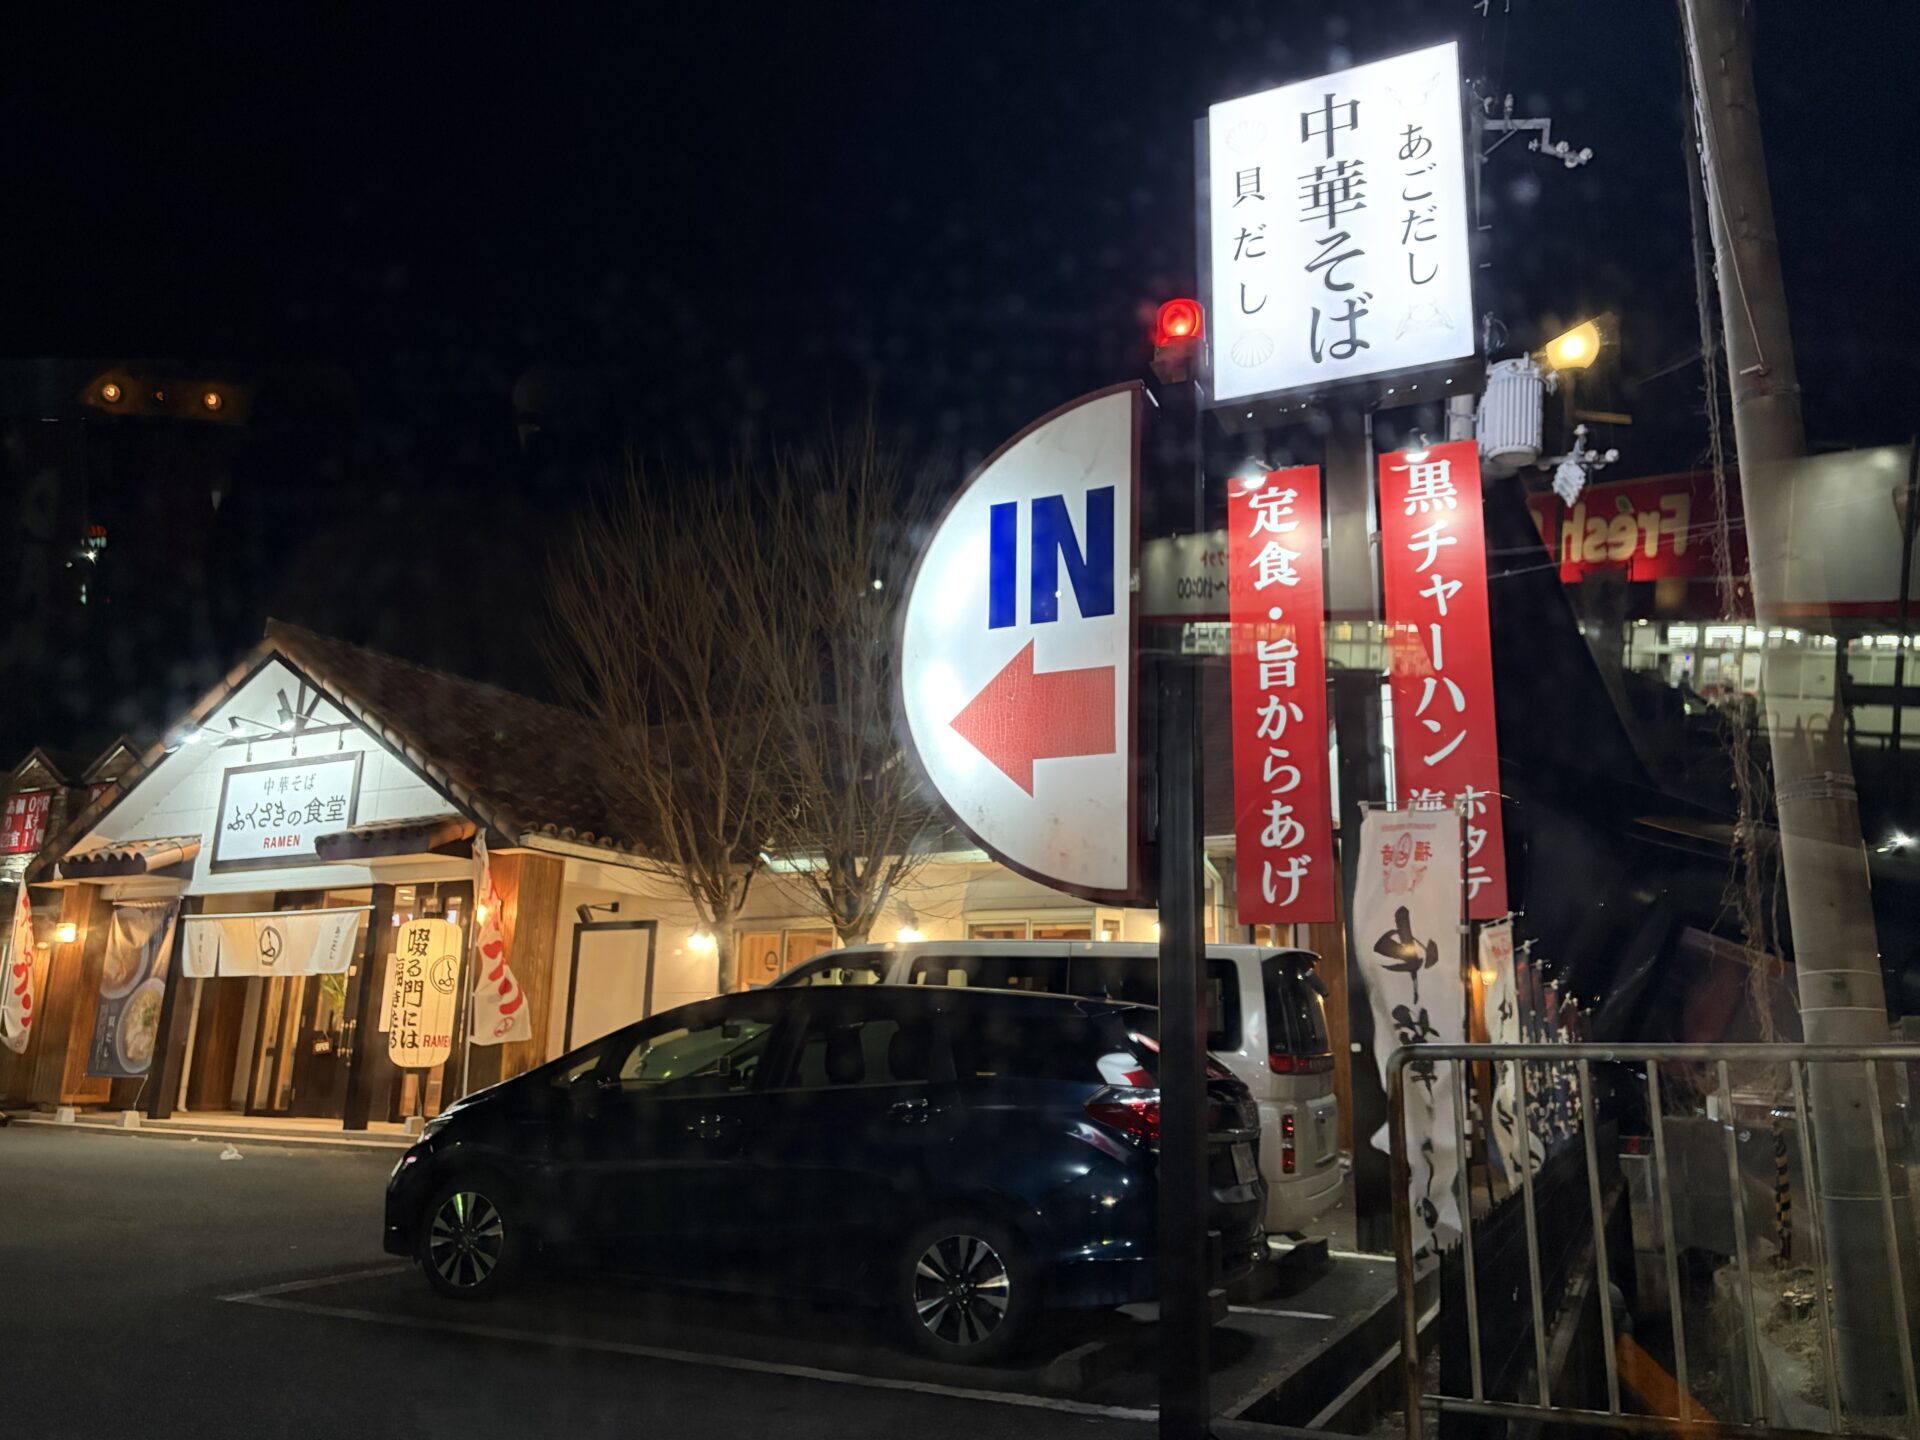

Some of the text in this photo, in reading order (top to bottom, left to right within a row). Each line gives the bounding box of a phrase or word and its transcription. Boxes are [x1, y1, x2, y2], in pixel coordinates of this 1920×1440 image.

[1232, 165, 1268, 316] 貝だし
[1296, 91, 1373, 364] 中華そば
[1397, 123, 1439, 286] あごだし
[987, 484, 1116, 631] IN
[1403, 459, 1468, 767] 黒チャーハン
[1248, 486, 1312, 907] 定食・旨からあげ
[227, 795, 347, 832] ふくさきの食堂
[262, 834, 301, 849] RAMEN
[263, 772, 317, 796] 中華そば
[400, 927, 432, 1050] 啜る門には
